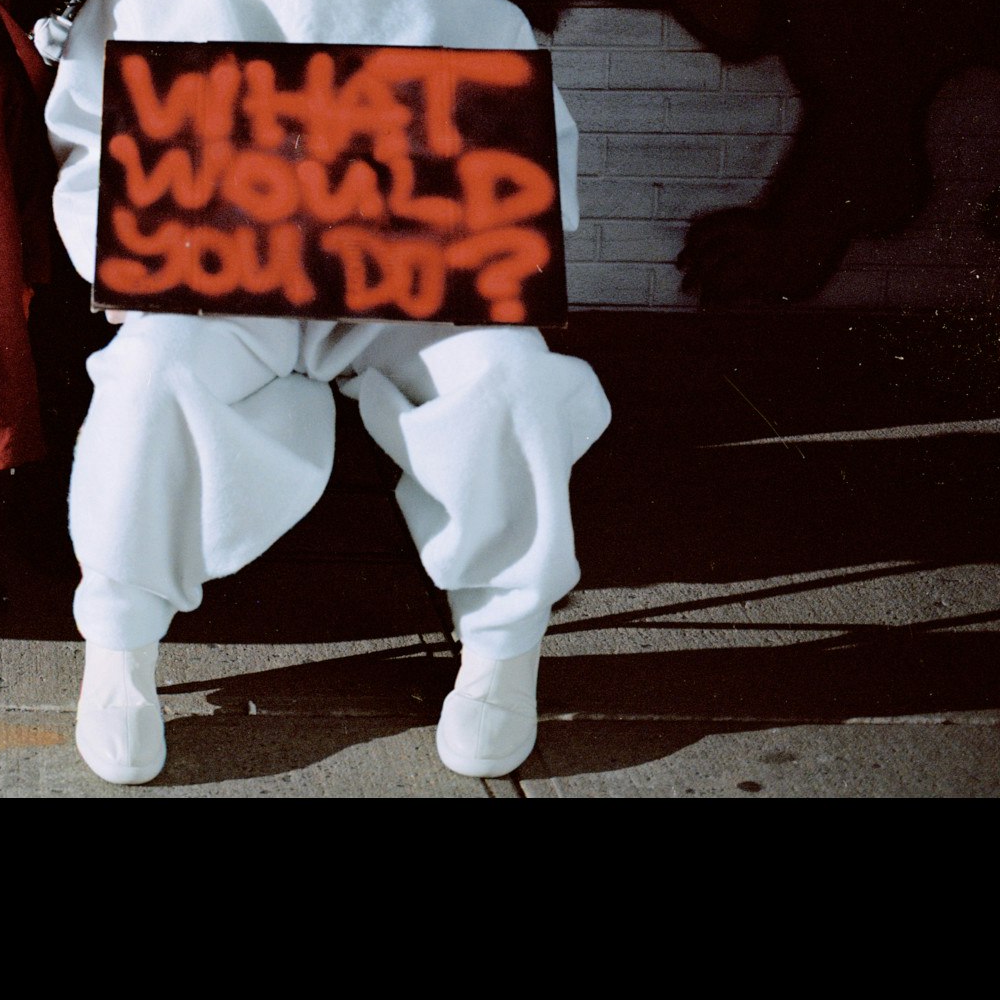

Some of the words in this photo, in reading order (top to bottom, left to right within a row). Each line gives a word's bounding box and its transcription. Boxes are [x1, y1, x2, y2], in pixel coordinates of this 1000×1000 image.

[120, 47, 532, 157] WHAT
[109, 132, 556, 232] WOULD
[99, 205, 317, 306] YOU
[322, 225, 551, 324] DO?
